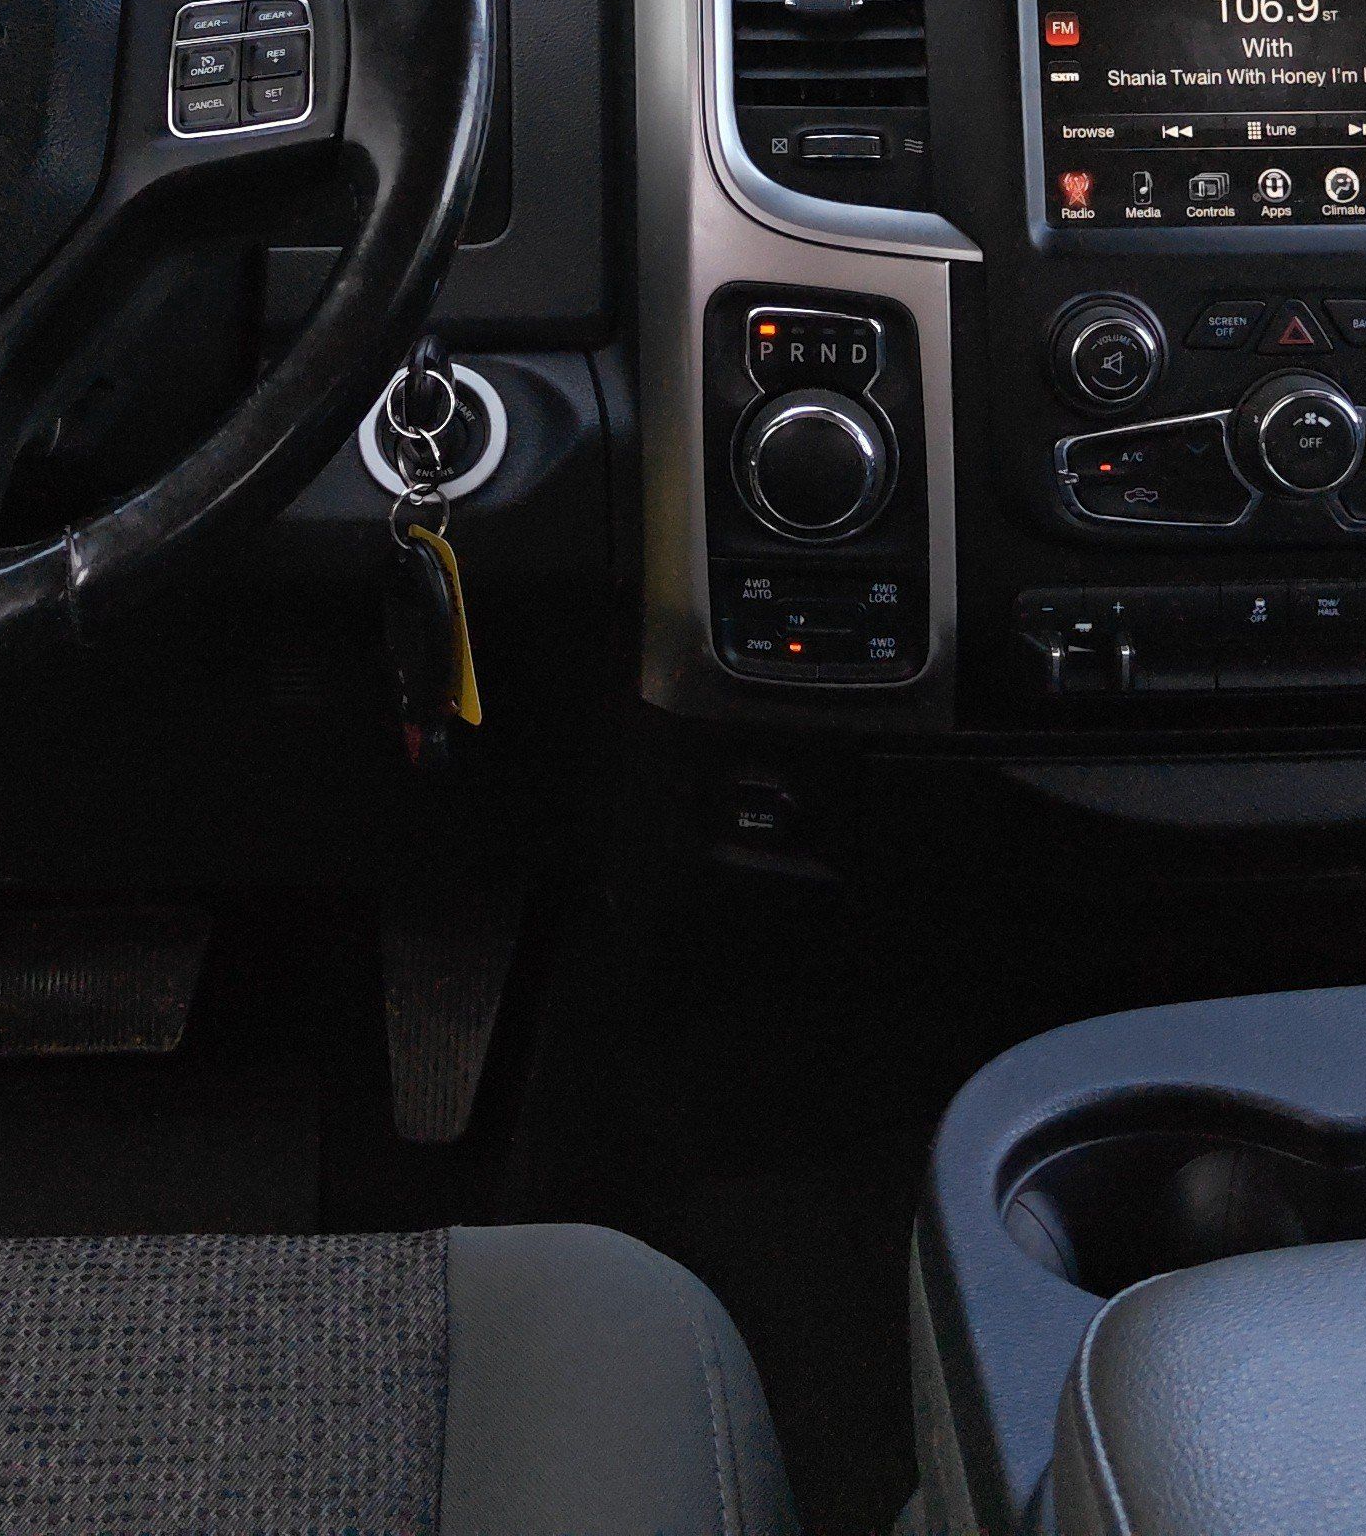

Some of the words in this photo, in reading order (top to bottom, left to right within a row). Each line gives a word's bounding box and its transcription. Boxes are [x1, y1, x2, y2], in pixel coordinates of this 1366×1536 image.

[1051, 21, 1075, 35] FM
[266, 49, 286, 58] RES
[1241, 37, 1293, 58] With
[190, 64, 225, 76] ON/OFF
[1107, 70, 1166, 87] Shania
[1170, 69, 1223, 85] Twain
[1226, 68, 1266, 85] With
[1270, 67, 1326, 87] Honey
[1331, 67, 1358, 83] I'm
[264, 87, 284, 99] SET
[188, 98, 224, 112] CANCEL
[1062, 125, 1115, 139] browse
[1266, 122, 1297, 136] tune
[1061, 207, 1096, 219] Radio
[1125, 206, 1162, 218] Media
[1186, 205, 1236, 218] Controls
[1260, 205, 1292, 218] Apps
[1321, 204, 1366, 216] Climate
[1208, 316, 1247, 326] SCREEN
[1215, 327, 1235, 338] OFF
[1096, 334, 1132, 345] VOLUME
[790, 342, 805, 363] R
[820, 343, 837, 364] N
[851, 343, 867, 364] D
[1299, 437, 1323, 449] OFF
[1121, 452, 1144, 462] A/C
[744, 577, 771, 589] 4WD
[871, 583, 897, 594] 4WD
[742, 589, 773, 600] AUTO
[868, 594, 898, 604] LOCK
[746, 639, 773, 651] 2WD
[869, 637, 896, 648] 4WD
[869, 648, 896, 660] LOW
